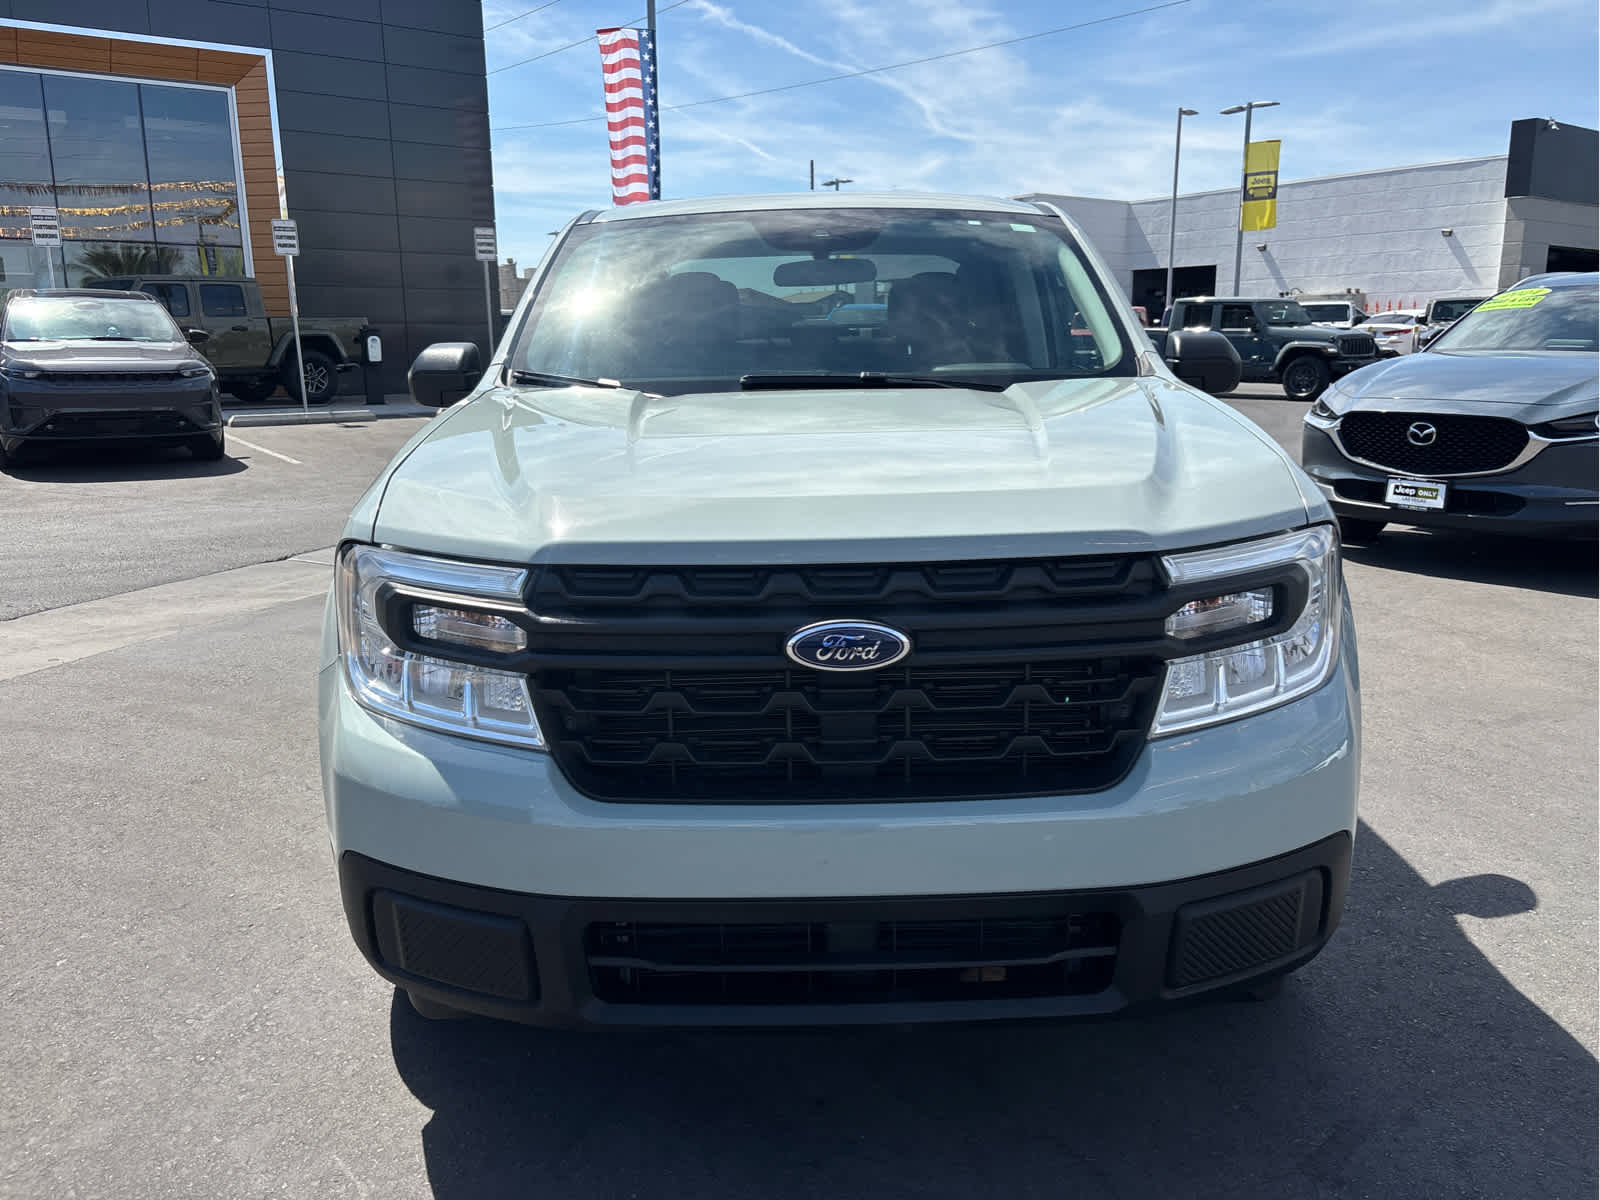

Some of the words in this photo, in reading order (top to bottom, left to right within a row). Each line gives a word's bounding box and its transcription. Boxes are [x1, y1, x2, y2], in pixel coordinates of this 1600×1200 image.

[1395, 486, 1416, 496] Jeep
[1417, 489, 1438, 497] ONLY
[816, 634, 881, 661] Ford
